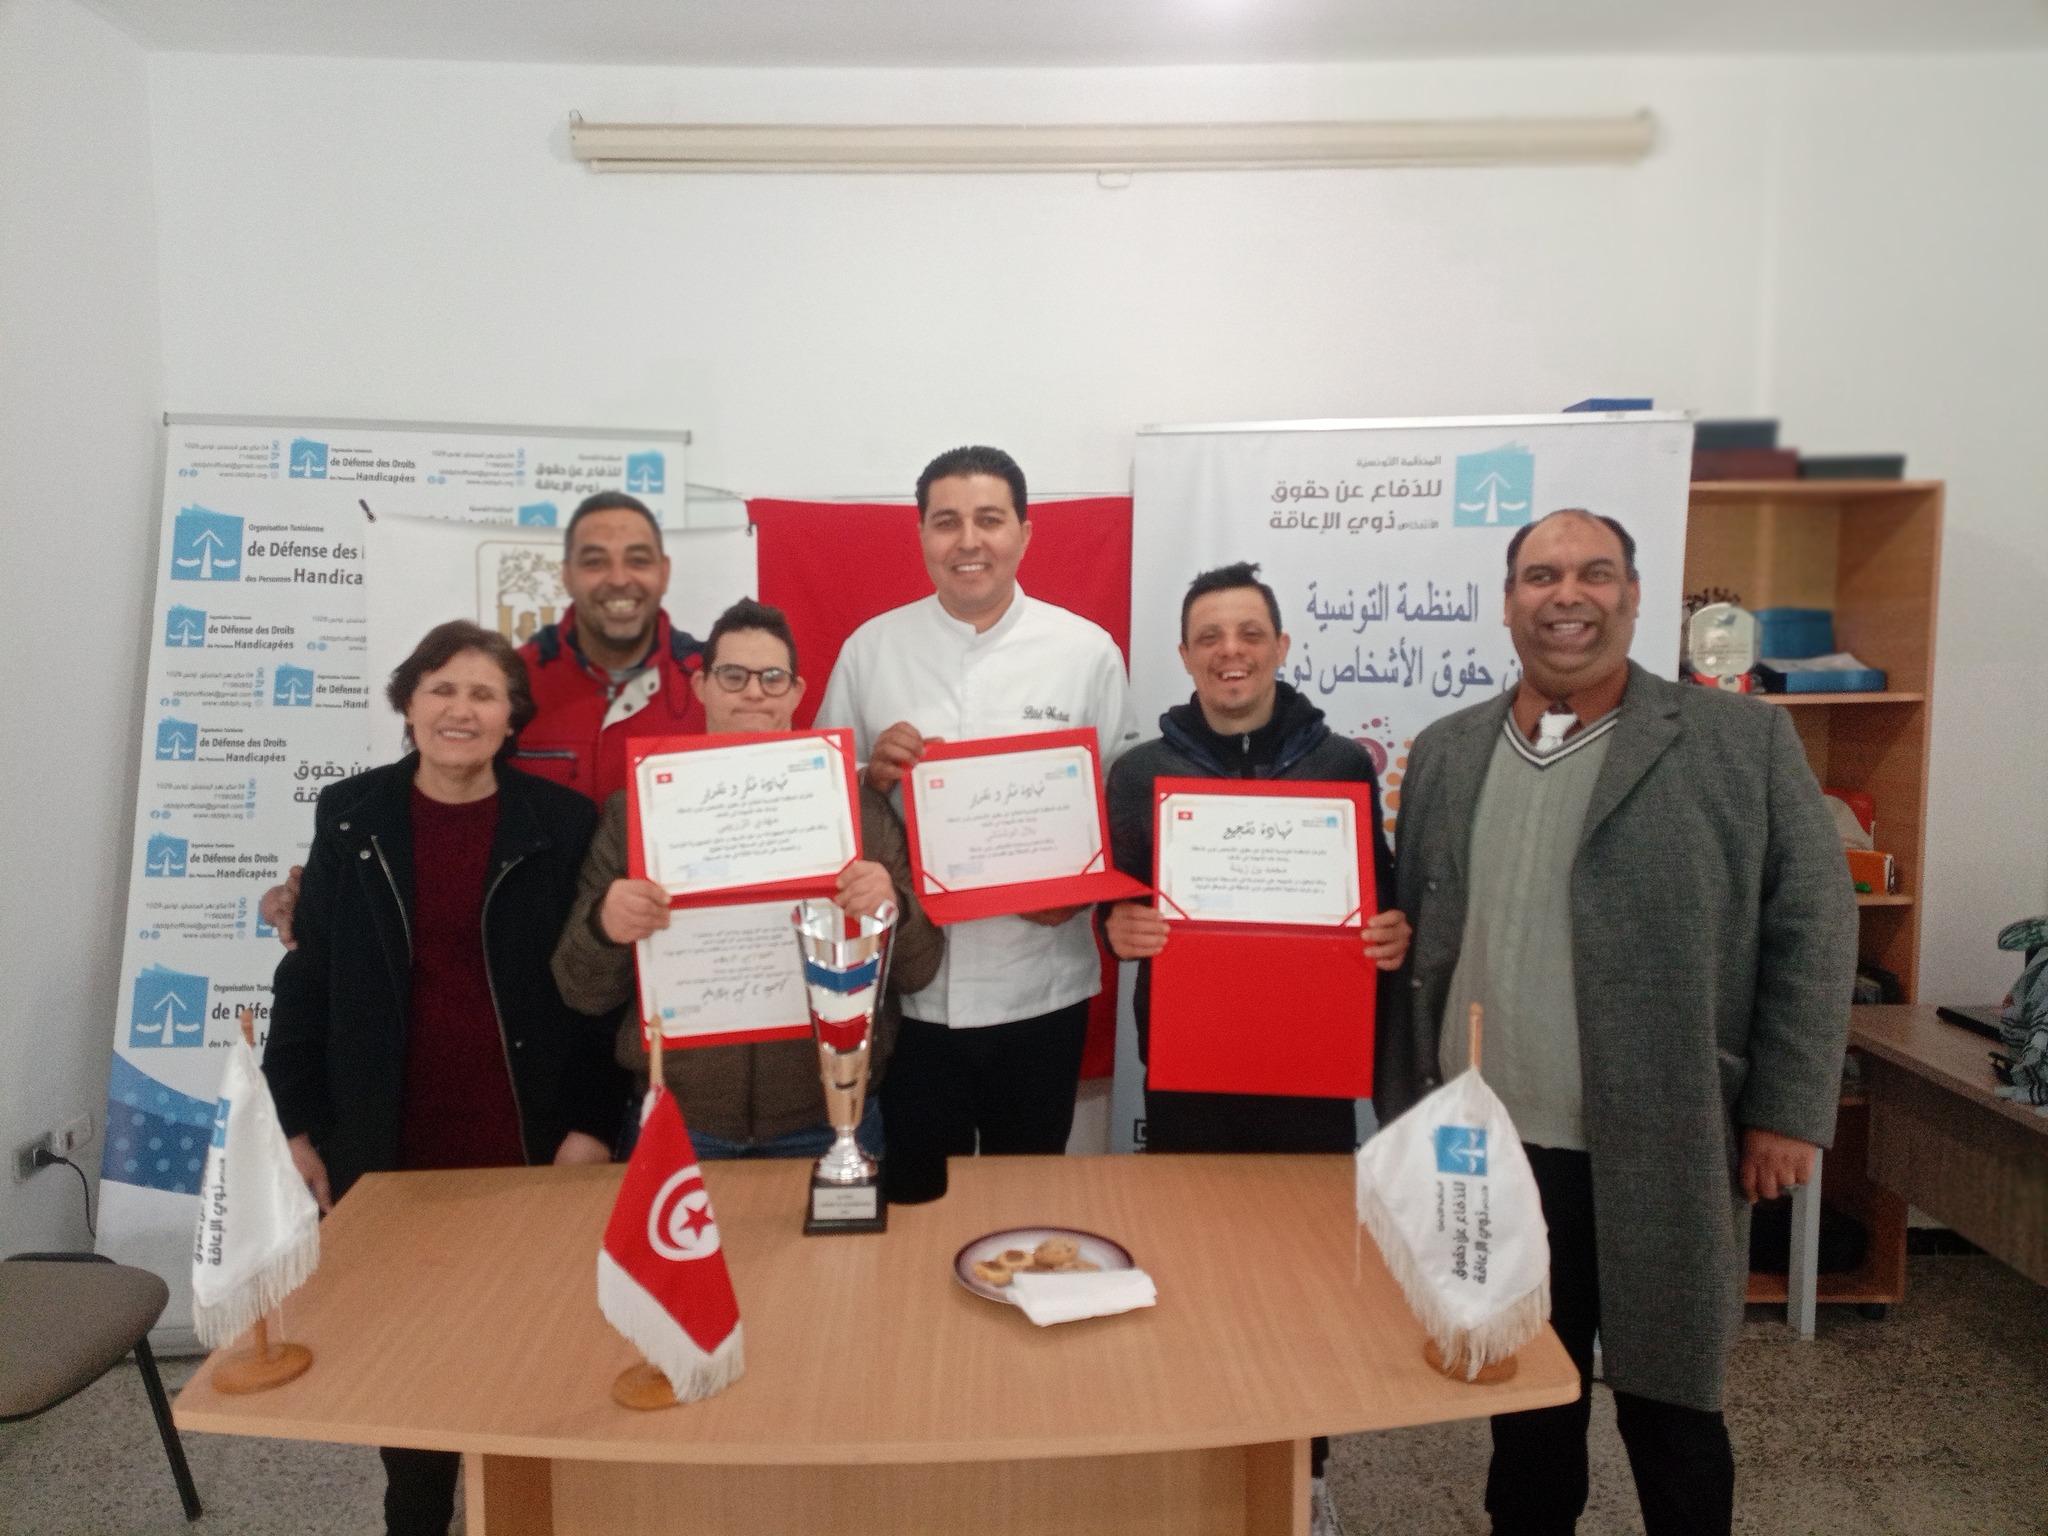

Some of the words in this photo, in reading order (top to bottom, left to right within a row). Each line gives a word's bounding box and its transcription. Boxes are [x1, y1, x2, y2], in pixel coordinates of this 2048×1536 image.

[330, 457, 340, 467] de
[343, 457, 375, 468] Défense
[376, 458, 390, 468] des
[392, 458, 416, 469] Droits
[355, 471, 416, 484] Handicapées
[1270, 480, 1330, 503] حقوق
[1336, 480, 1364, 503] عن
[248, 523, 289, 533] Organisation
[1269, 511, 1341, 535] الإعاقة
[1347, 510, 1395, 535] ذوي
[247, 541, 265, 557] de
[269, 541, 328, 558] Défense
[332, 543, 358, 560] des
[1306, 580, 1389, 634] التونسية
[1396, 580, 1479, 623] المنظمة
[208, 624, 219, 634] de
[220, 624, 254, 635] Défense
[255, 625, 270, 635] des
[271, 625, 295, 635] Droits
[234, 639, 295, 652] Handicapées
[1319, 636, 1423, 696] الأشخاص
[1432, 646, 1494, 699] حقوق
[199, 737, 210, 748] de
[212, 737, 246, 748] Défense
[247, 738, 261, 748] des
[263, 738, 288, 748] Droits
[226, 752, 287, 765] Handicapées
[293, 760, 345, 781] حقوق
[190, 853, 201, 863] de
[203, 852, 236, 864] Défense
[238, 853, 252, 863] des
[254, 852, 279, 863] Droits
[217, 868, 278, 880] Handicapées
[211, 1001, 231, 1020] de
